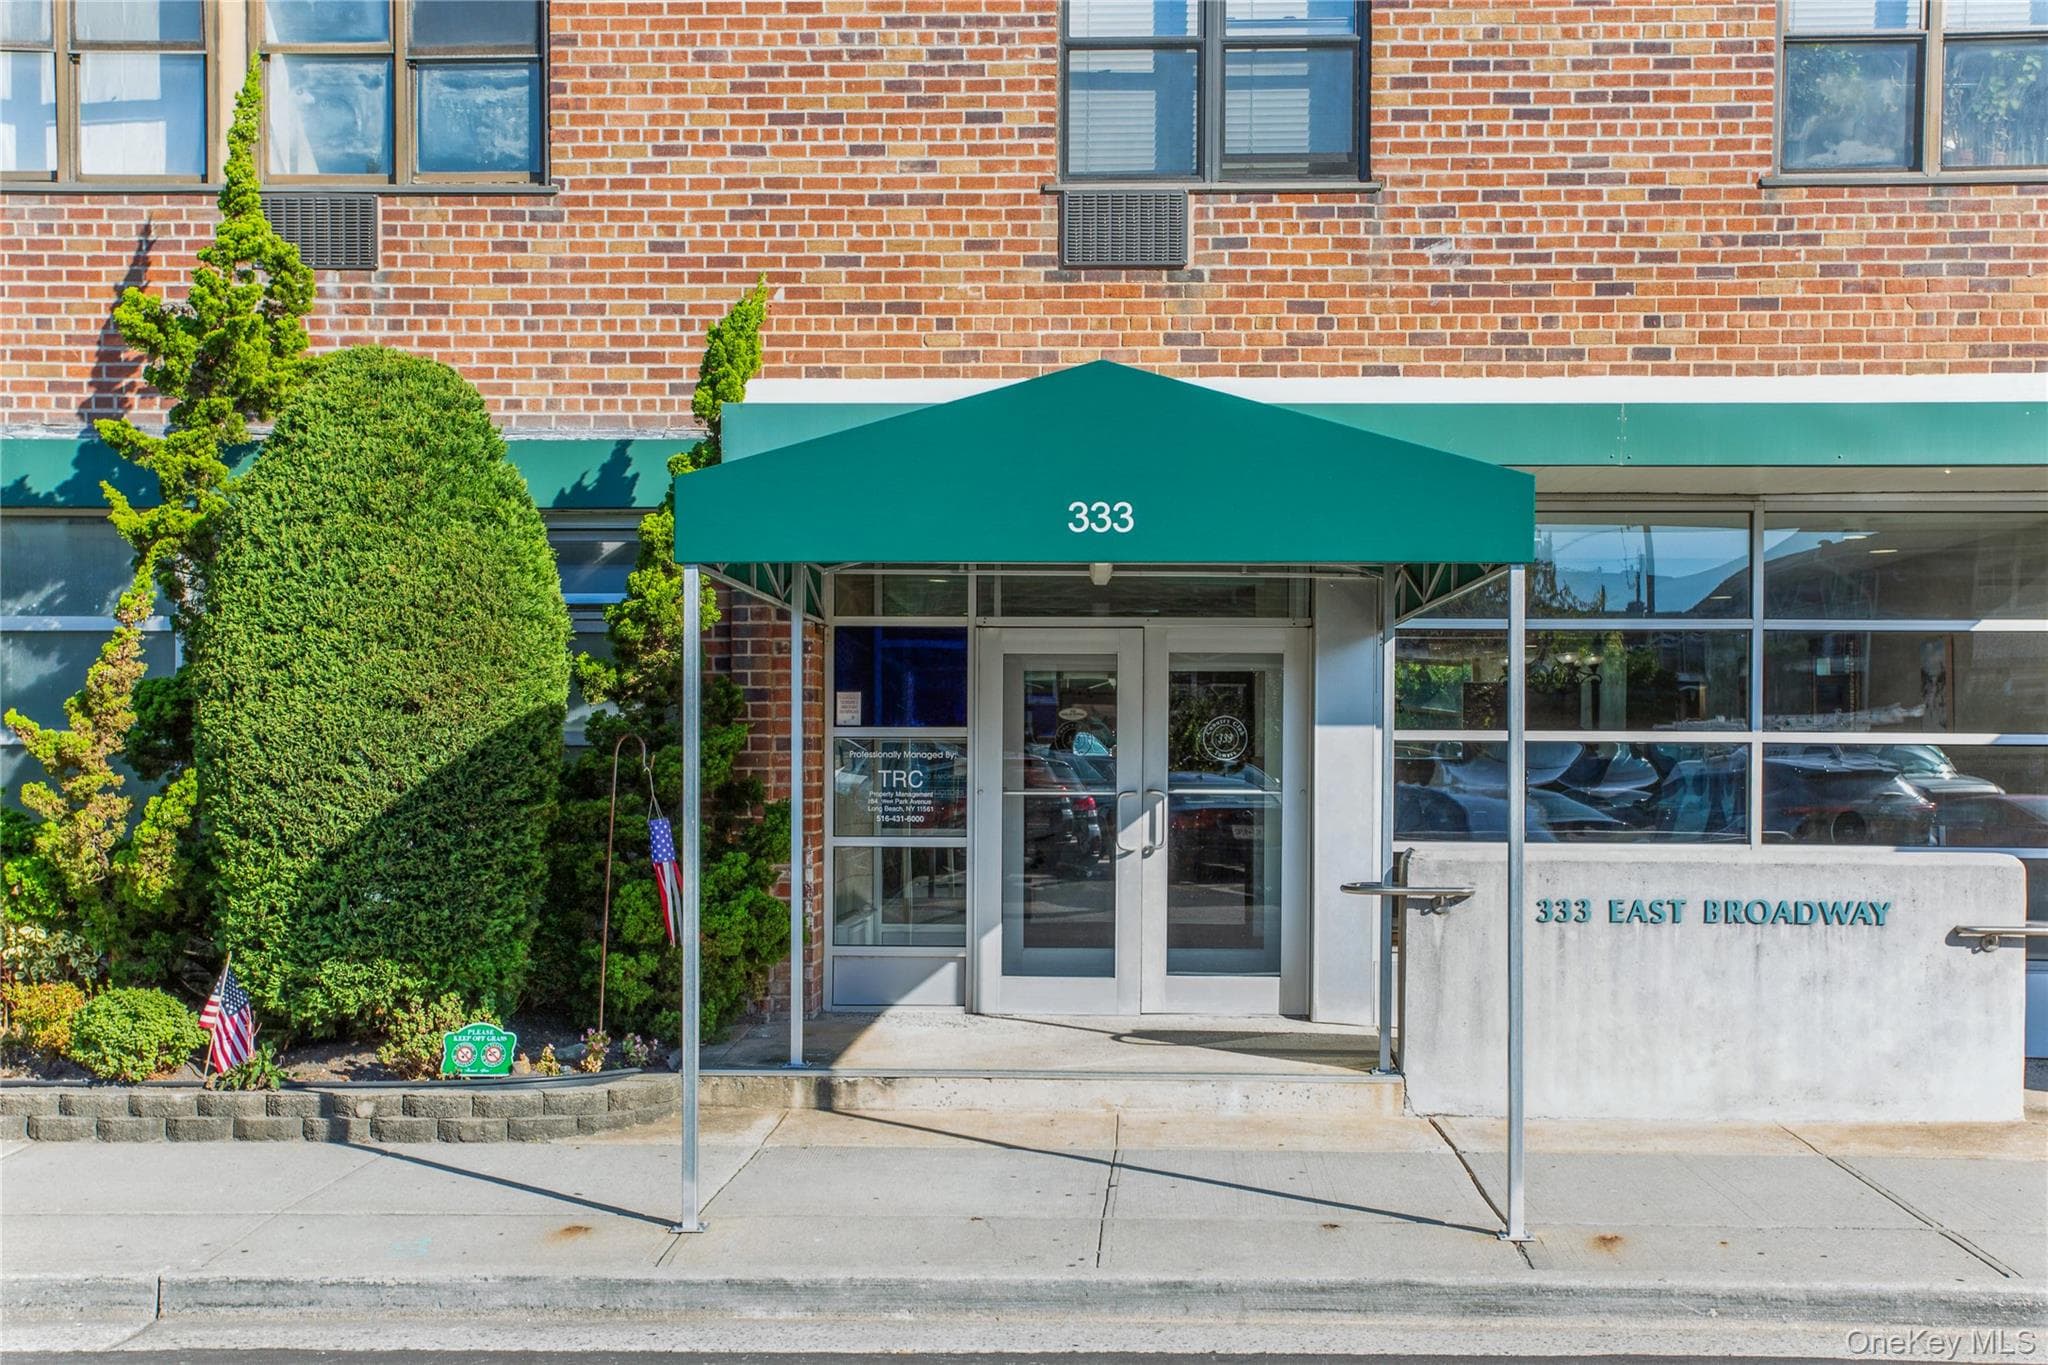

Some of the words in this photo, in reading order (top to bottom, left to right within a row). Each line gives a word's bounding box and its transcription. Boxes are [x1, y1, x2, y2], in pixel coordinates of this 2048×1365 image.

[1068, 501, 1134, 533] 333
[849, 750, 902, 759] Professionally
[903, 750, 944, 760] Managed
[878, 769, 924, 788] TRC
[1535, 899, 1592, 922] 333
[1608, 899, 1687, 923] EAST
[1703, 899, 1892, 926] BROADWAY
